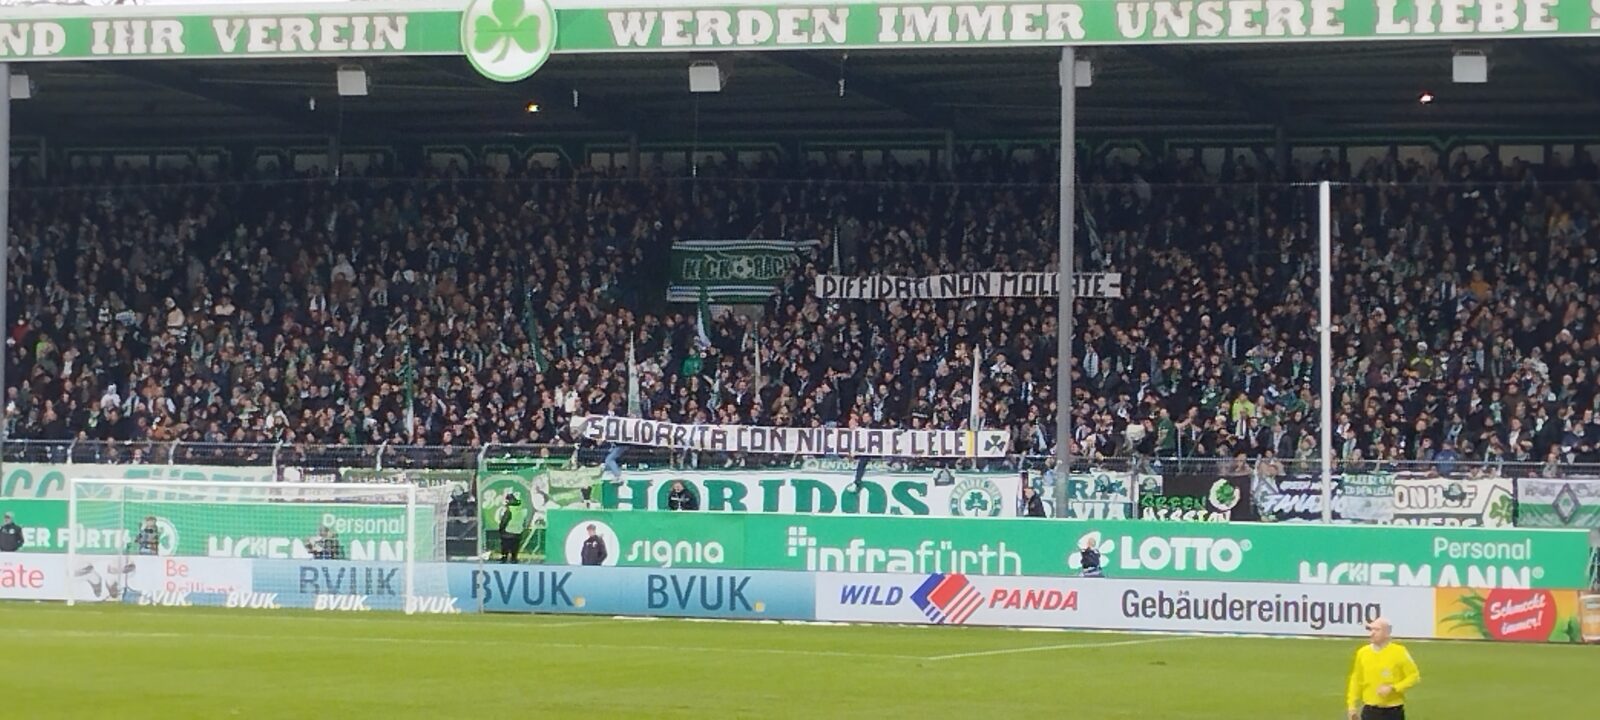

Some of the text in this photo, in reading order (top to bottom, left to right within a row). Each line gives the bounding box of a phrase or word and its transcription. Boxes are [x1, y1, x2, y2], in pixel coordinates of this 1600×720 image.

[91, 19, 186, 54] IHR
[212, 16, 408, 53] VEREIN
[607, 9, 850, 47] WERDEN
[878, 4, 1086, 43] IMMER
[1116, 0, 1345, 38] UNSERE
[1375, 0, 1559, 34] LIEBE
[822, 274, 932, 298] DIFFIDATI
[940, 273, 991, 297] NON
[736, 426, 787, 451] CON
[797, 427, 884, 454] NICOLA
[892, 430, 903, 454] E
[912, 430, 966, 456] LELE
[601, 478, 930, 516] HORIDOS
[322, 512, 405, 535] Personal
[1433, 536, 1532, 561] Personal
[166, 558, 189, 577] Be
[839, 584, 1079, 612] WILD PANDA
[1121, 588, 1382, 631] Gebäudereinigung
